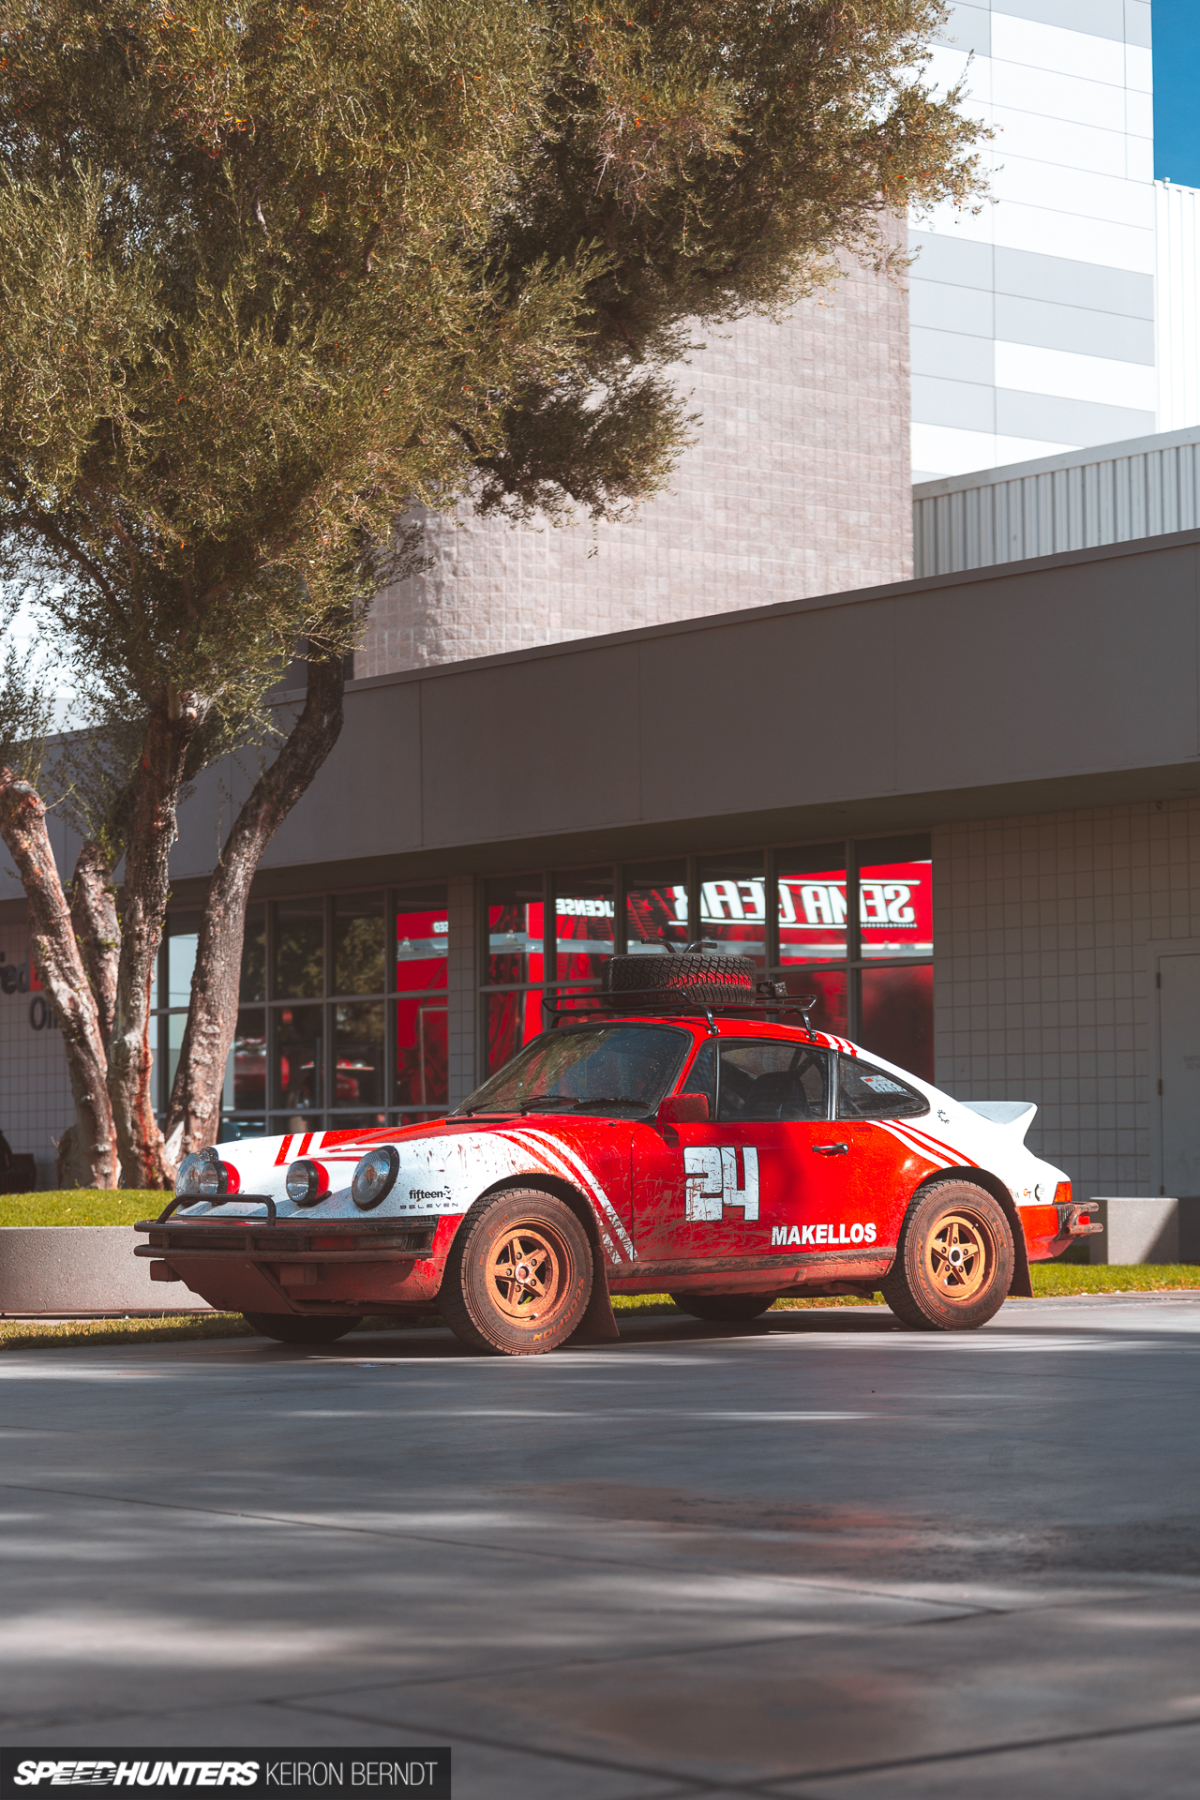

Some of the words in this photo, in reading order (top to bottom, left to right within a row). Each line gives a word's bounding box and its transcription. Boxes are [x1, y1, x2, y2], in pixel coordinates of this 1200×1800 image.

[409, 1189, 444, 1200] fifteen
[683, 1145, 760, 1222] 24
[771, 1223, 877, 1246] MAKELLOS
[533, 1276, 586, 1342] SCORPION
